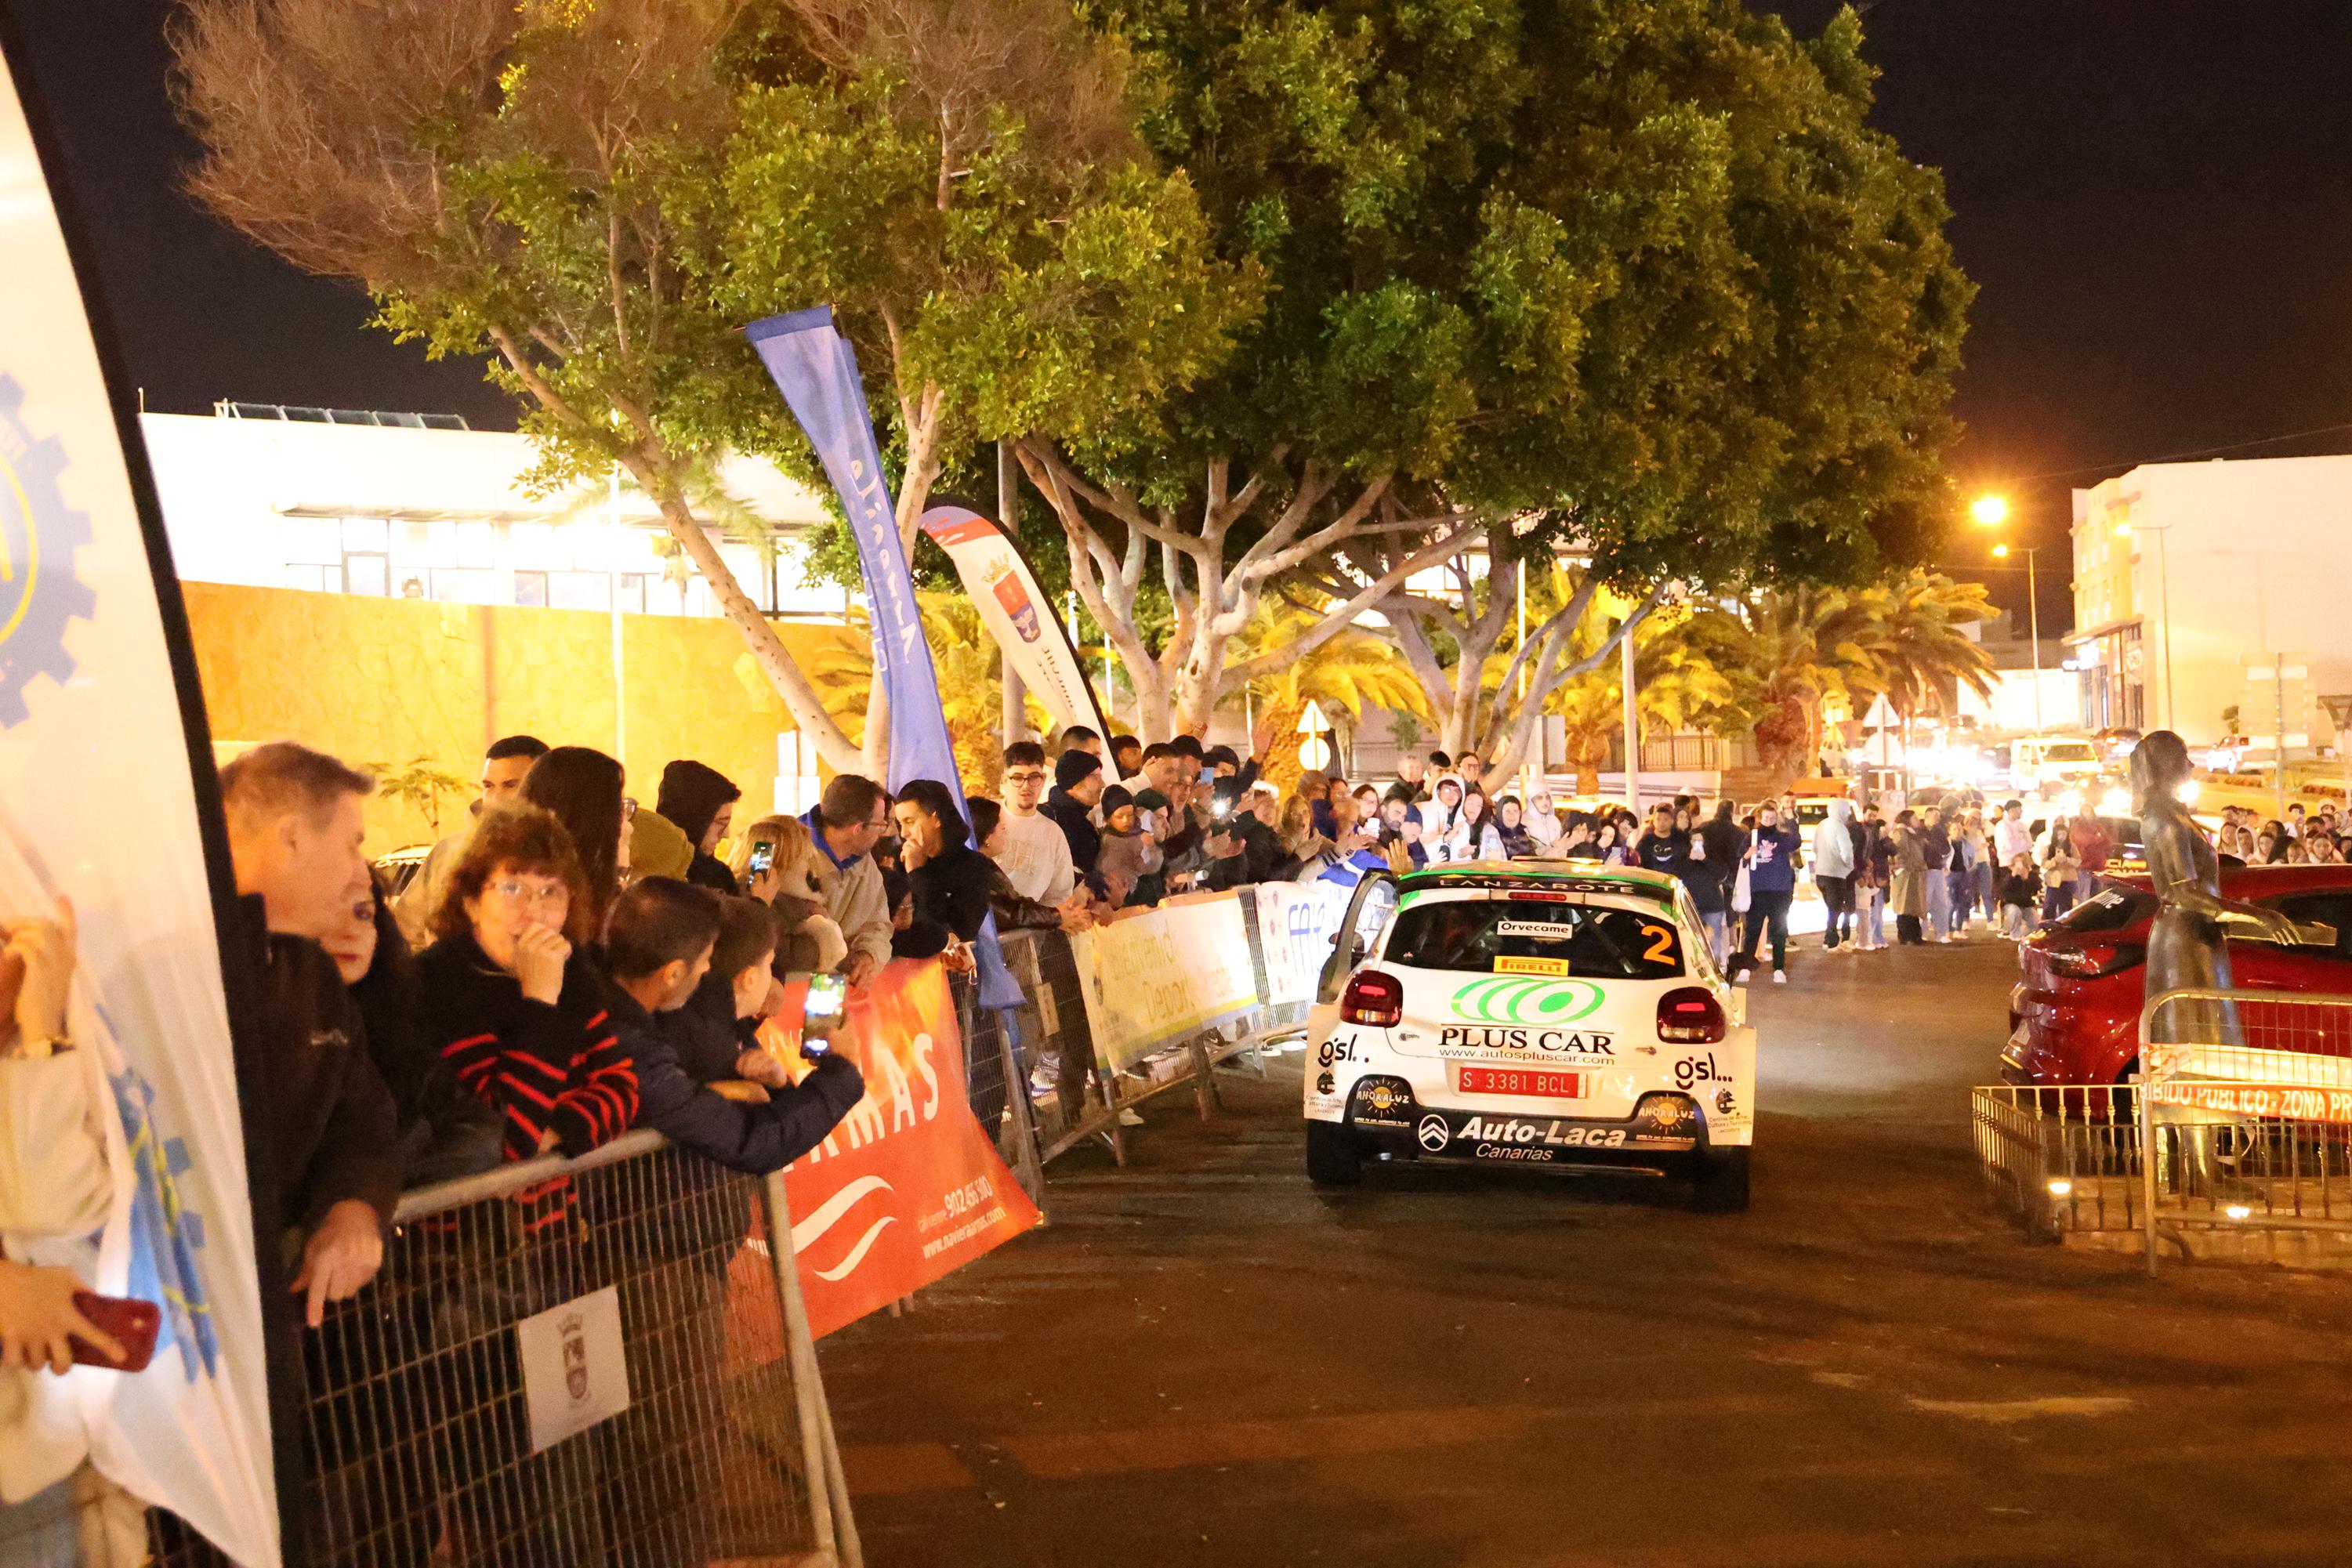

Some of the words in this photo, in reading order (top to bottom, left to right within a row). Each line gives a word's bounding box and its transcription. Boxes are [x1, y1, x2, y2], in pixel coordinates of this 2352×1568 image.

[1440, 879, 1635, 893] LANZAROTE
[1501, 922, 1569, 934] Orvecame
[1641, 925, 1676, 965] 2
[1501, 958, 1562, 972] PIRELLI
[1438, 1027, 1528, 1049] PLUS
[1538, 1031, 1616, 1055] CAR
[1439, 1048, 1615, 1065] www.autospluscar.com
[1462, 1071, 1473, 1088] S
[1485, 1072, 1528, 1090] 3381
[1537, 1075, 1569, 1092] BCL
[2279, 1089, 2325, 1118] ZONA
[1457, 1116, 1626, 1146] Auto-Laca
[1476, 1143, 1554, 1161] Canarias
[944, 1188, 967, 1218] 902
